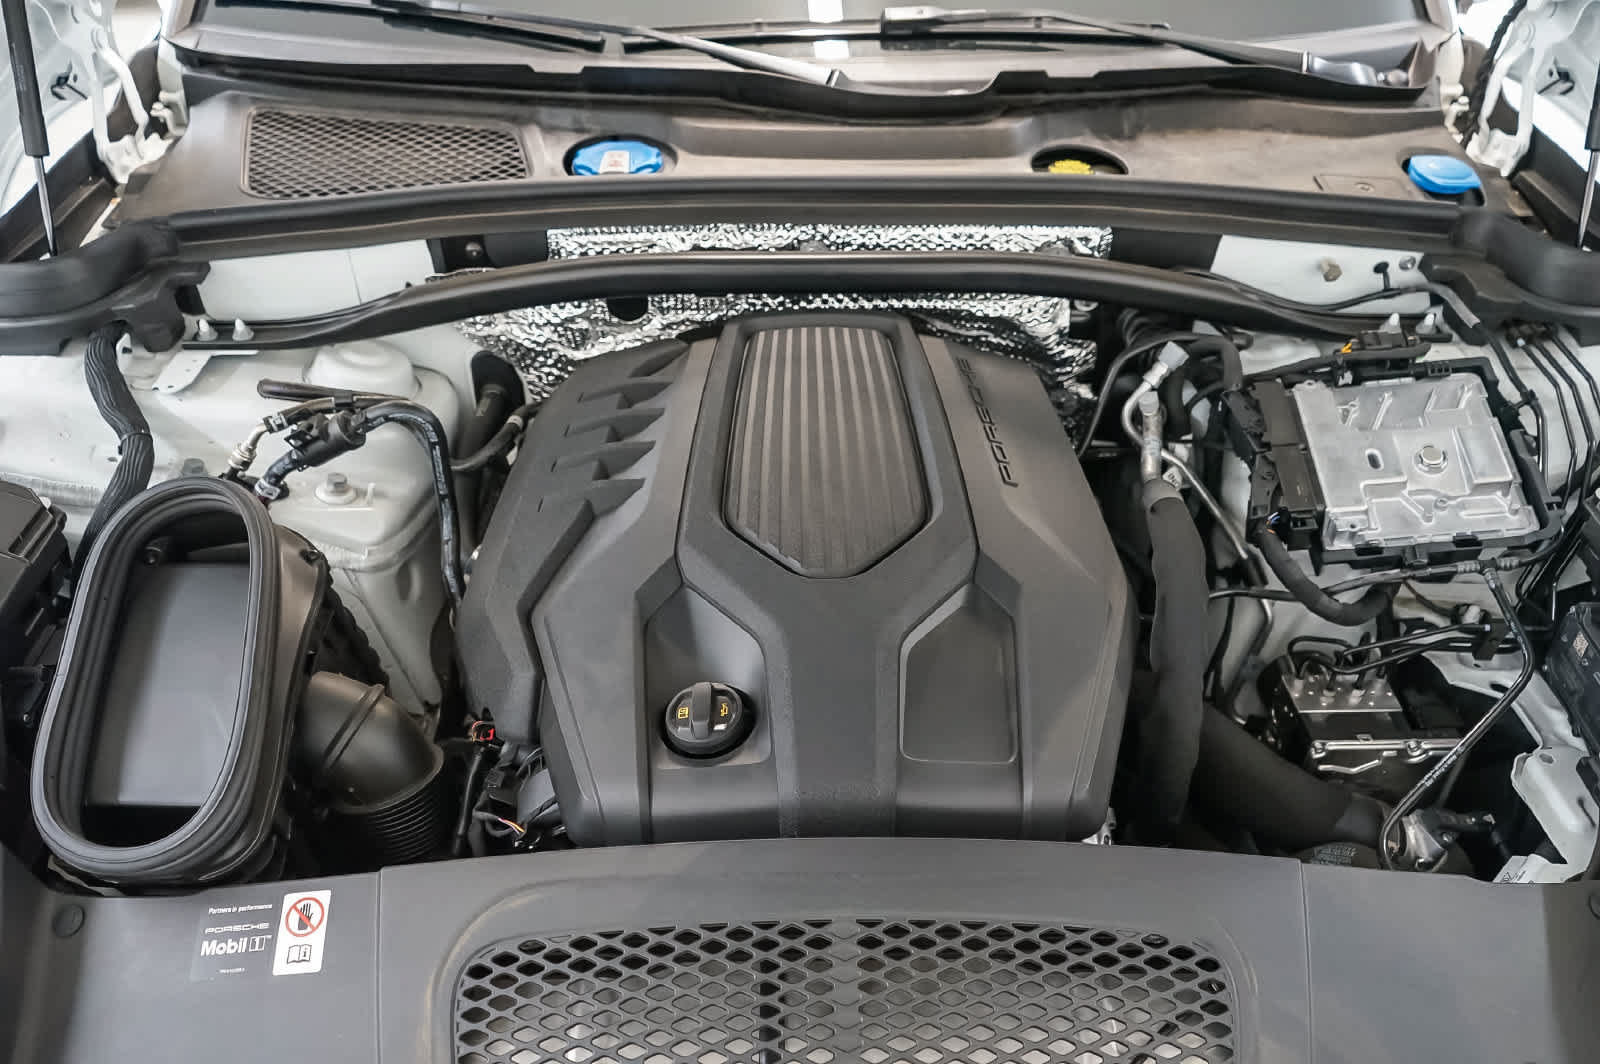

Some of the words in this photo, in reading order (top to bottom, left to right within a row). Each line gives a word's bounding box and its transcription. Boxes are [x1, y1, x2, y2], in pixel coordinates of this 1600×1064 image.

[957, 357, 1018, 488] PORSCHE
[238, 904, 272, 912] performance
[205, 923, 269, 934] PORSCHE
[200, 937, 248, 956] Mobil
[249, 936, 265, 952] 1
